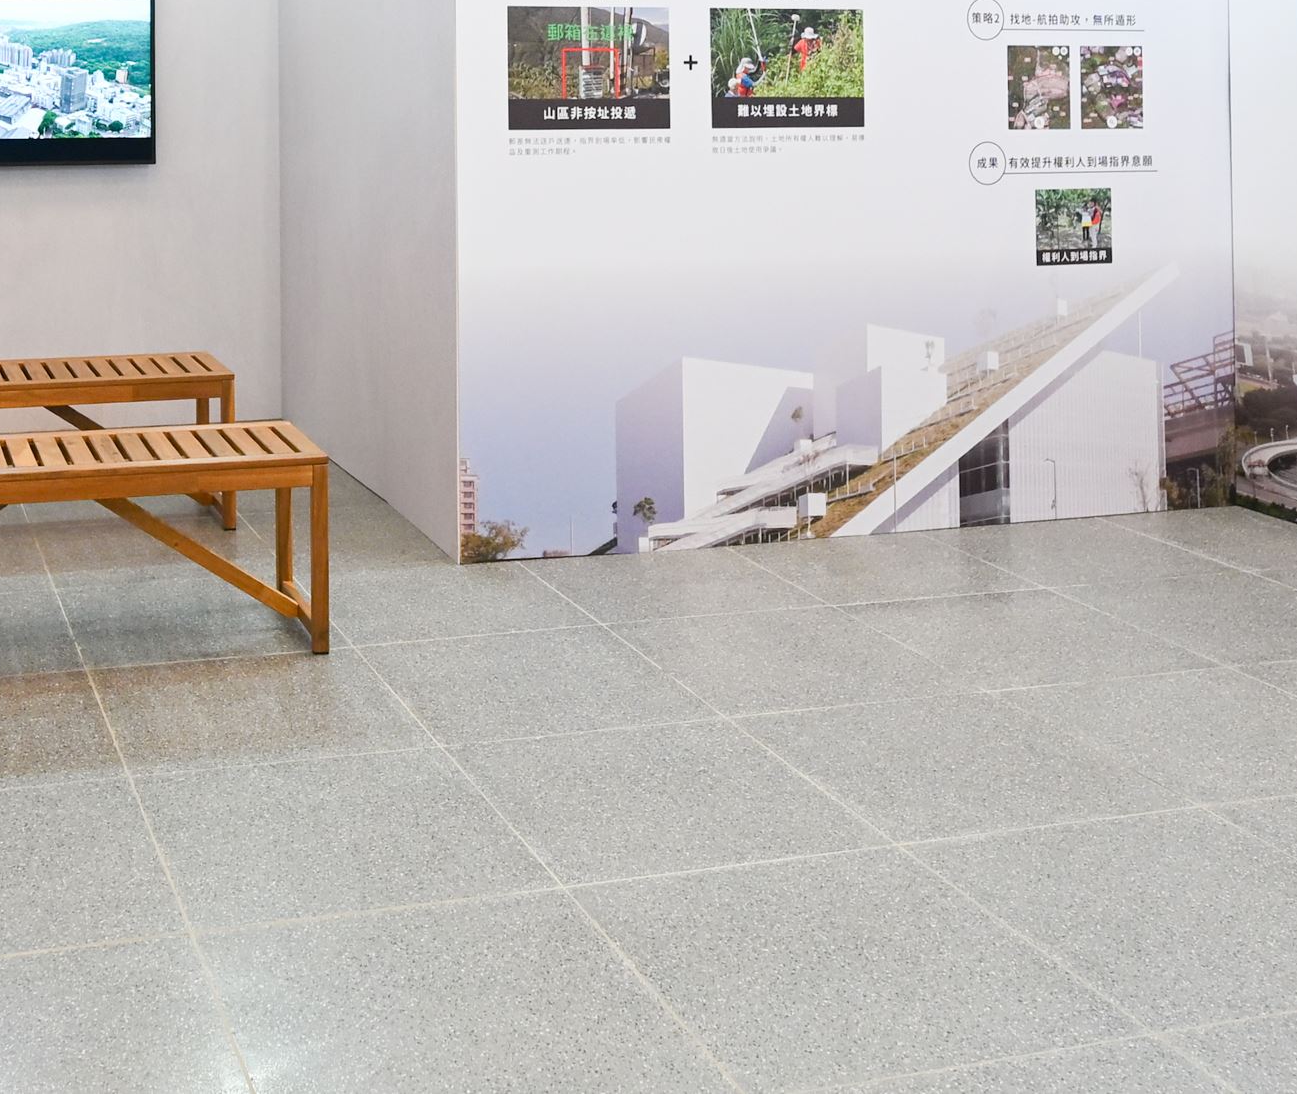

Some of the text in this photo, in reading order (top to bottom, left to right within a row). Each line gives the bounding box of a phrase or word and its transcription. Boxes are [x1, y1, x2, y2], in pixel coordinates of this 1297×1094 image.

[972, 12, 1000, 24] 策略2
[543, 106, 637, 121] 山區非按址投遞
[737, 104, 838, 118] 難以埋設土地界標
[977, 157, 999, 169] 成果
[1009, 155, 1153, 169] 有效提升權利人到場指界意願
[1042, 250, 1108, 262] 權利人到場指界
